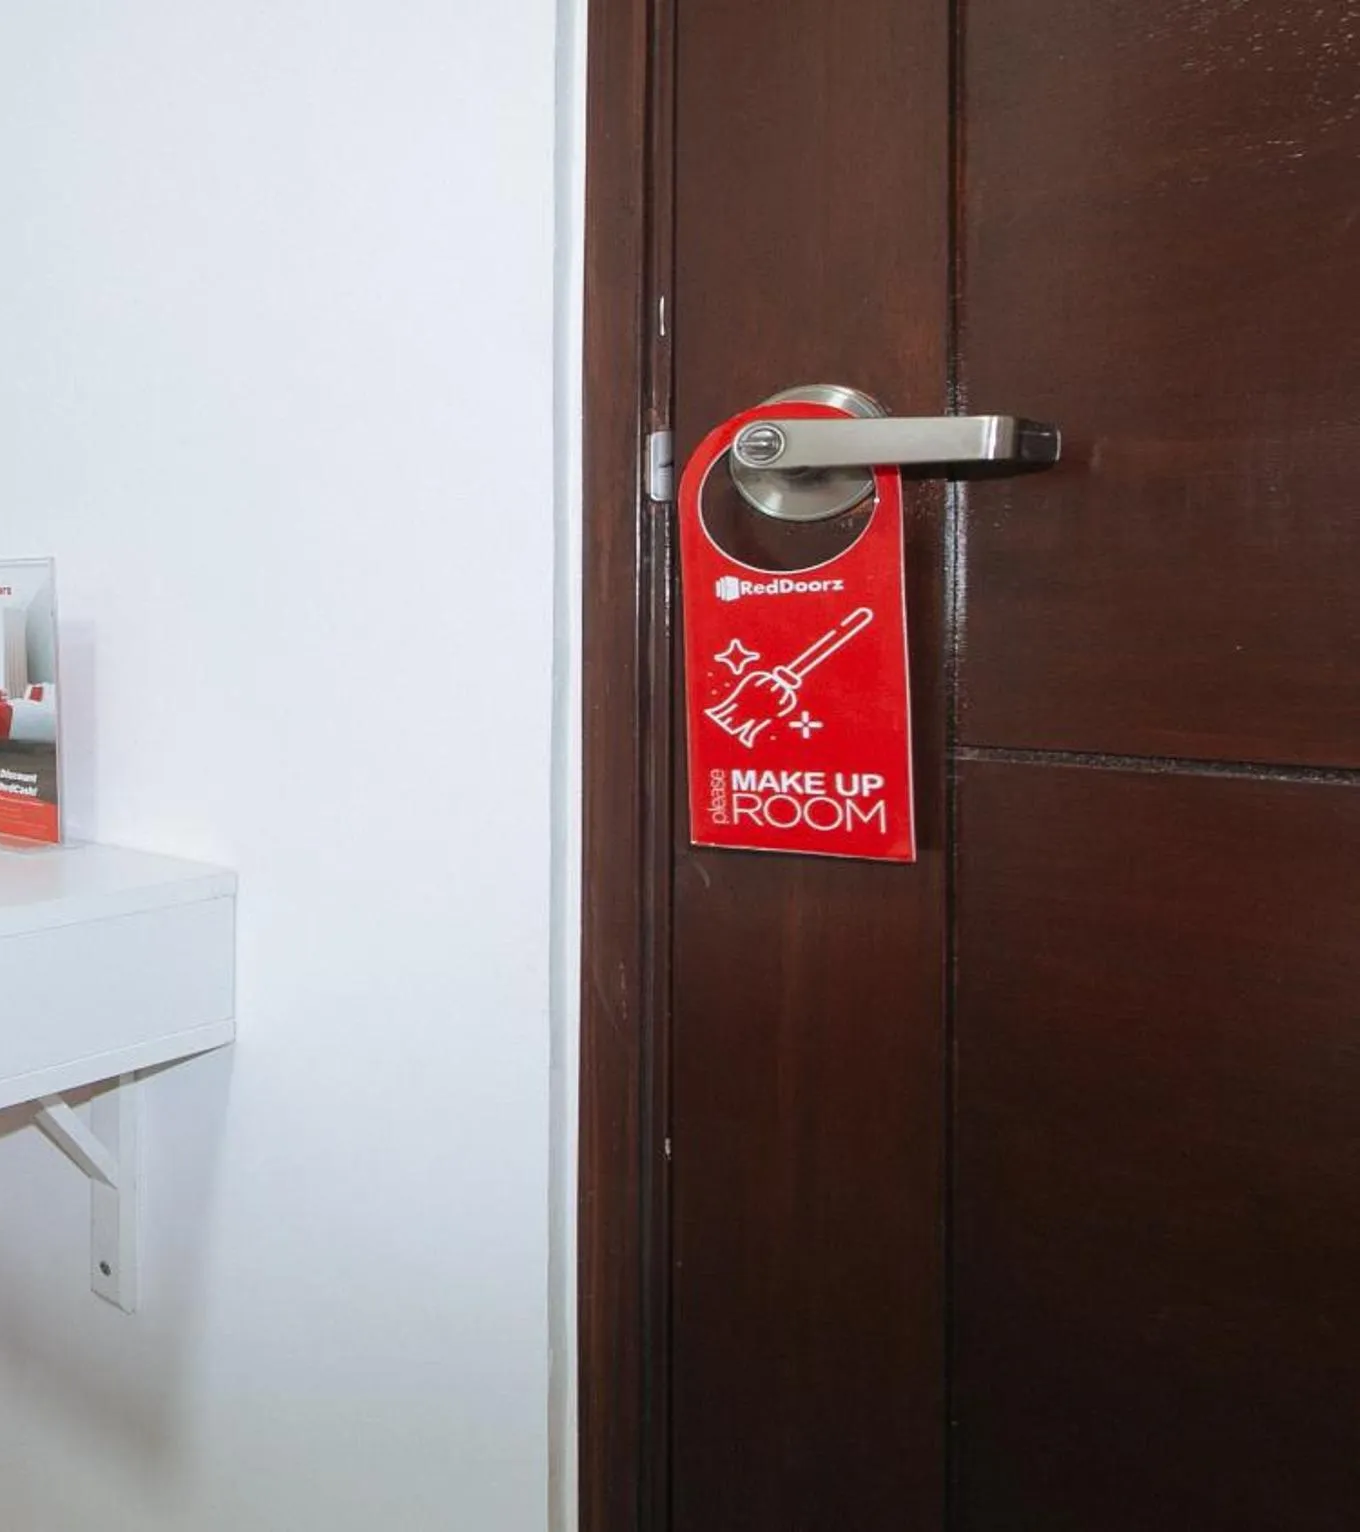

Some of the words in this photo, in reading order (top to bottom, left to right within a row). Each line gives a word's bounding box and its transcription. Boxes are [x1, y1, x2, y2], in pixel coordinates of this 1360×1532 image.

[740, 578, 844, 595] RedDoorz
[0, 767, 38, 784] Discount
[731, 768, 827, 796] MAKE
[835, 771, 885, 798] UP
[707, 768, 730, 825] please
[732, 792, 887, 835] ROOM
